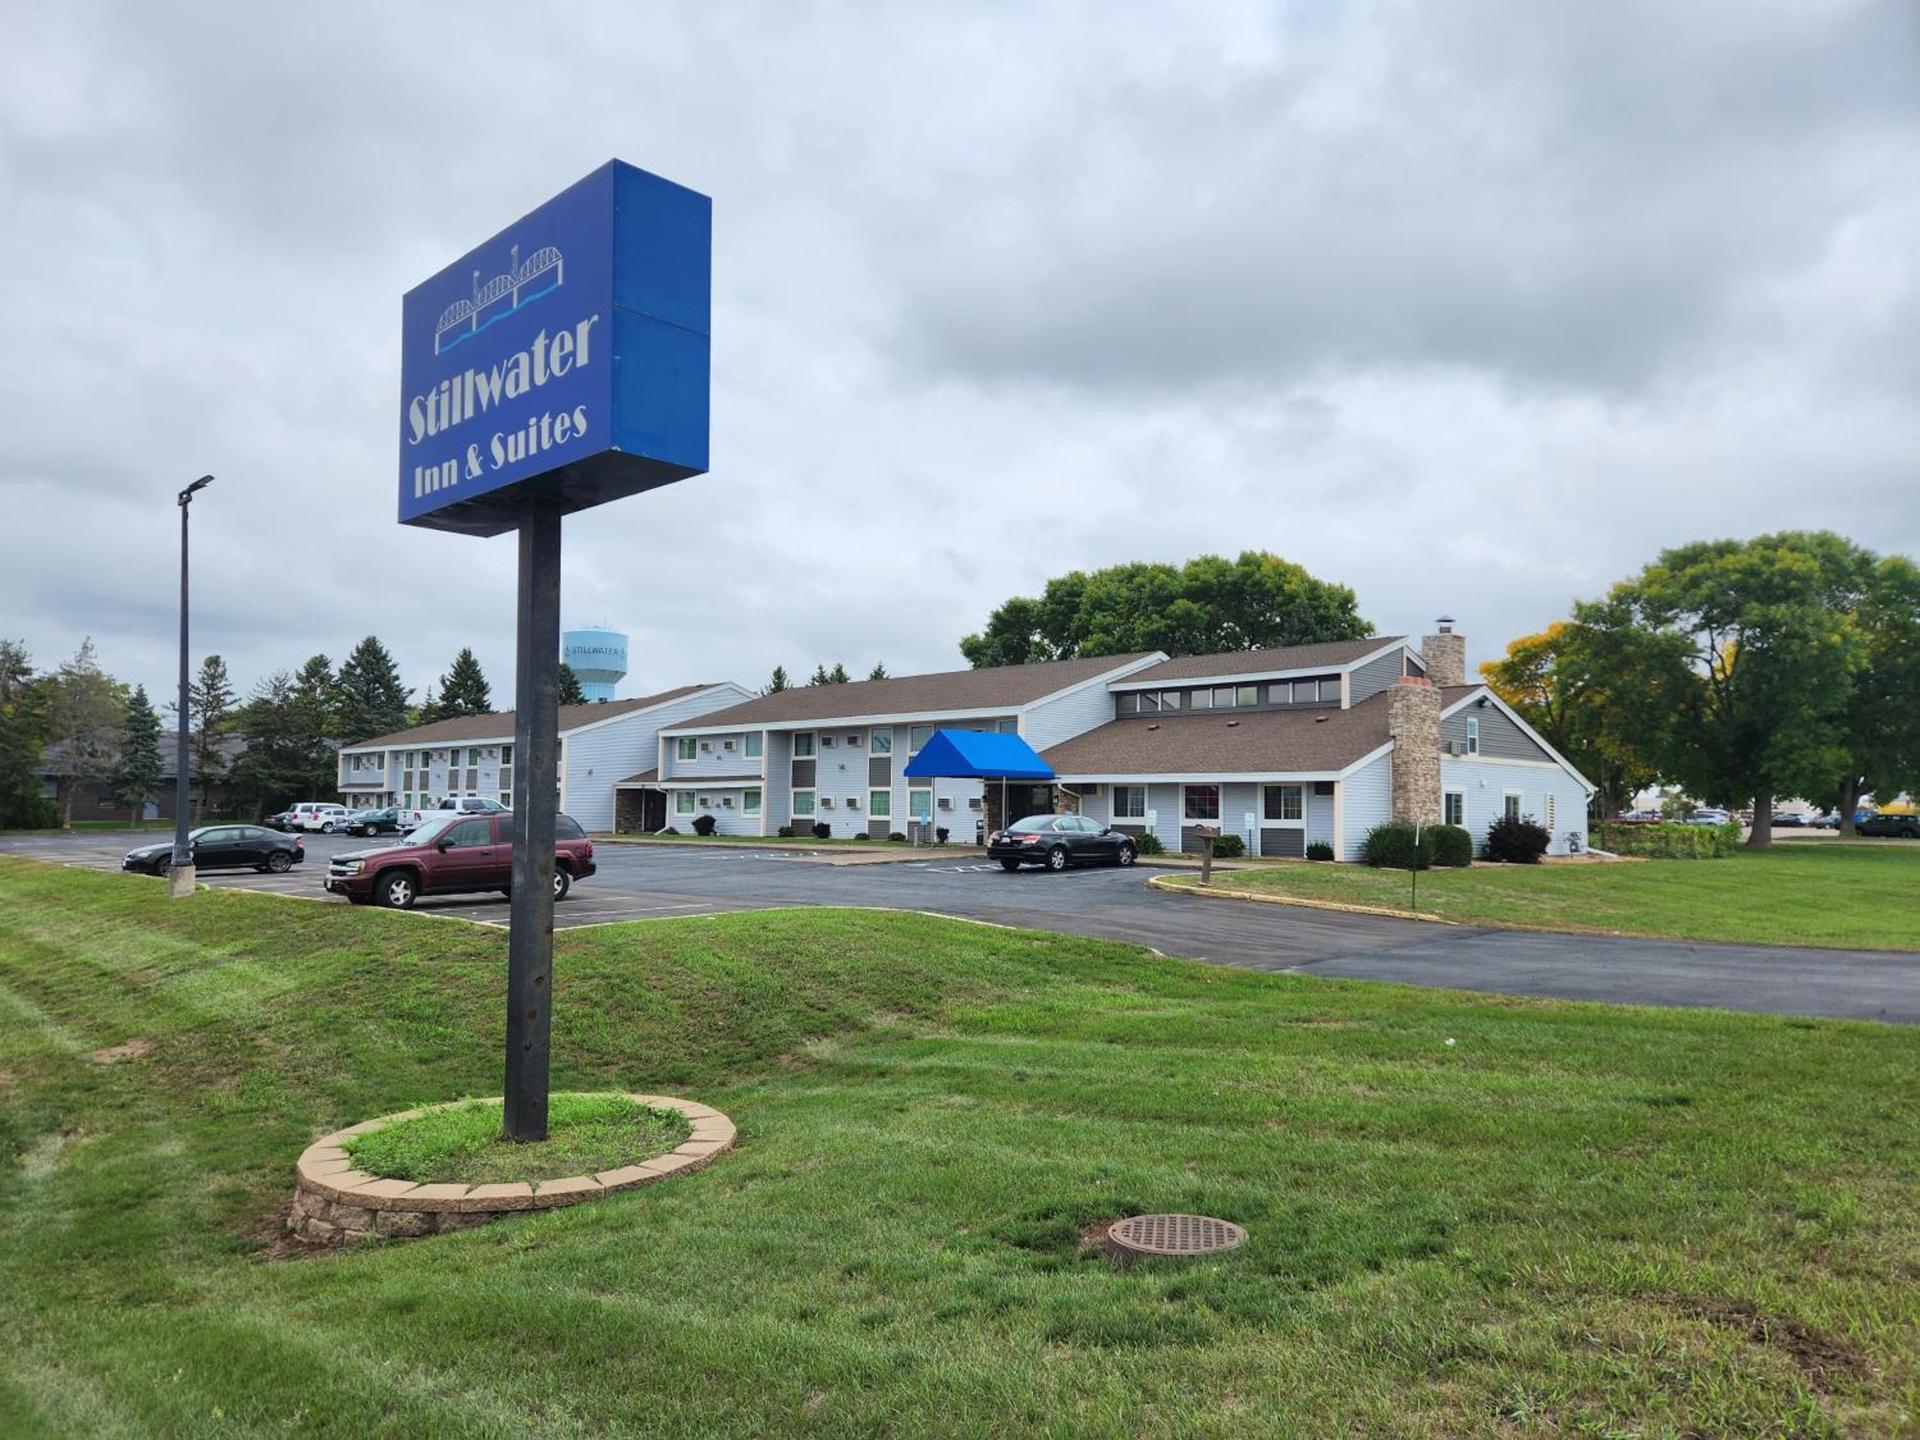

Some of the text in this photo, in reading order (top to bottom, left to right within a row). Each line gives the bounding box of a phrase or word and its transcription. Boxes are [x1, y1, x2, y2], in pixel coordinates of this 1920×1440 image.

[408, 314, 599, 445] Stillwater
[414, 405, 588, 498] Inn & Suites
[572, 646, 618, 655] STILLWATER
